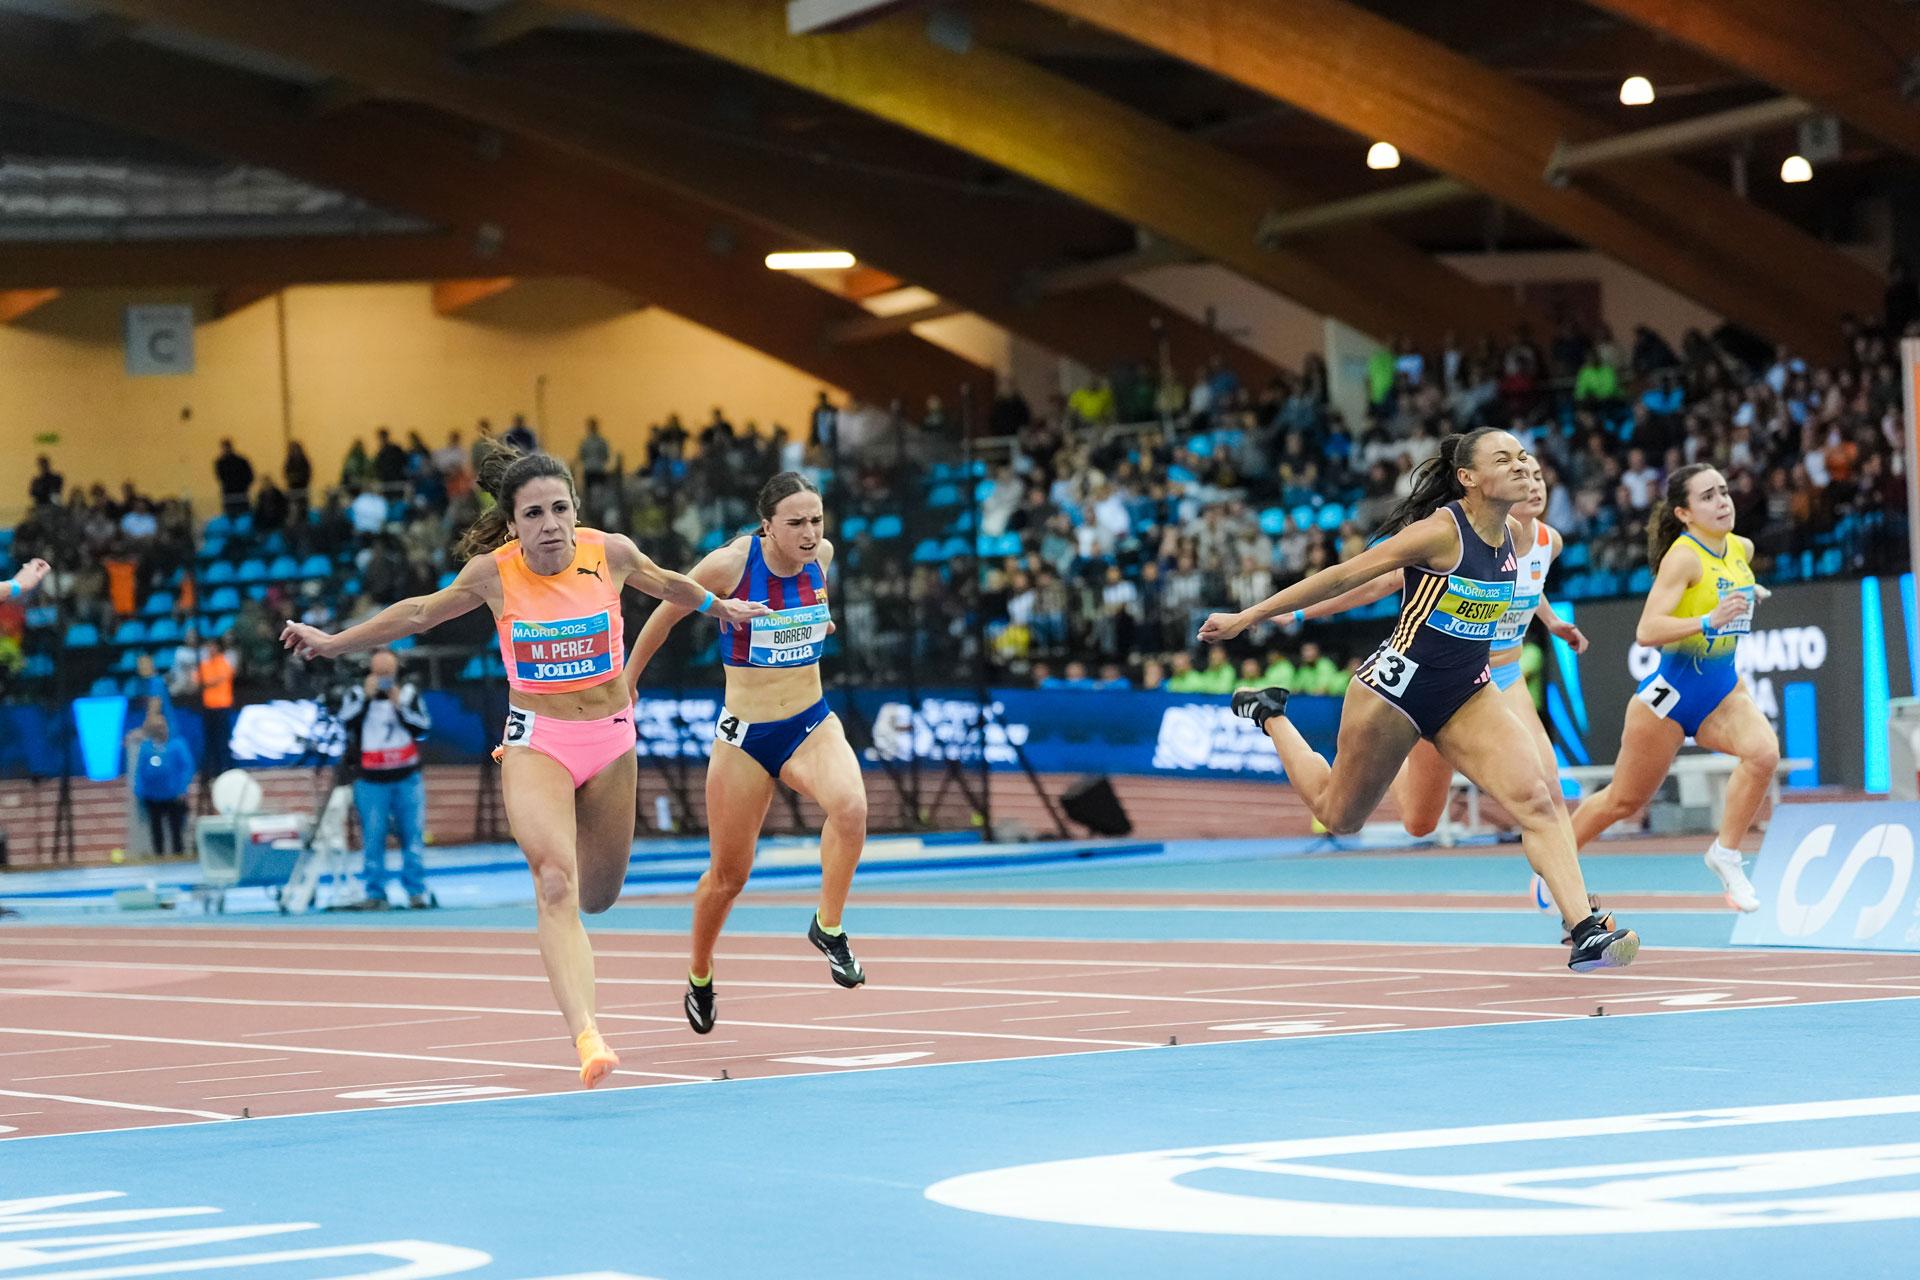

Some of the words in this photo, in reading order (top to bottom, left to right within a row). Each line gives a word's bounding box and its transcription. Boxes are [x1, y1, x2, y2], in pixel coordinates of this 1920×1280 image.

[147, 328, 177, 363] C
[1450, 583, 1486, 598] MADRID
[1486, 588, 1500, 598] 2025
[513, 627, 559, 638] MADRID
[560, 623, 588, 636] 2025
[755, 616, 792, 628] MADRID
[793, 613, 813, 624] 2025
[1444, 617, 1490, 636] Joma
[774, 626, 812, 644] BORRERO
[531, 644, 549, 660] M.
[551, 638, 595, 660] PEREZ
[767, 645, 814, 664] Joma
[534, 659, 596, 680] Joma
[1378, 655, 1406, 688] 3
[1651, 686, 1671, 708] 1
[507, 710, 527, 741] 5
[719, 716, 740, 742] 4
